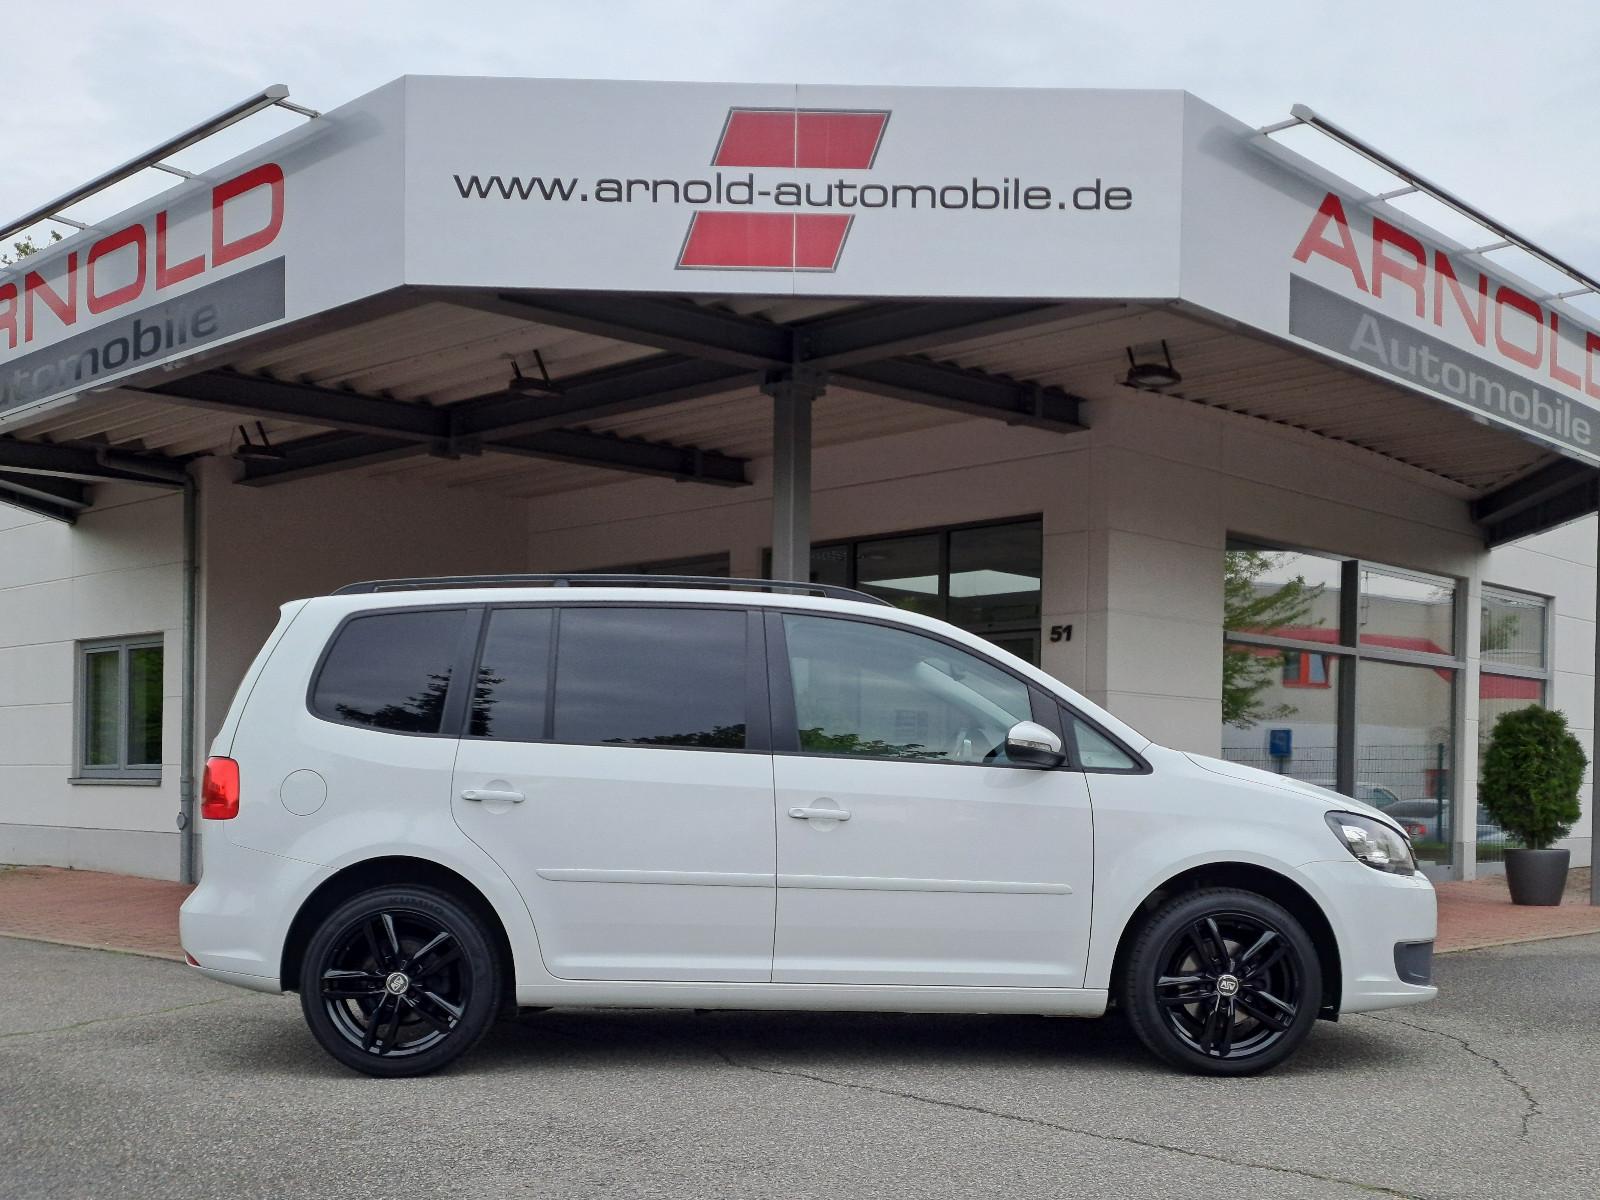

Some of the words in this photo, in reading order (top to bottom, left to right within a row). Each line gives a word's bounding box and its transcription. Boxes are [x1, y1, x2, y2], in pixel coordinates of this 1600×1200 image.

[453, 171, 1133, 210] www.arnold-automobile.de
[1349, 313, 1592, 446] Automobile
[1050, 624, 1073, 642] 51
